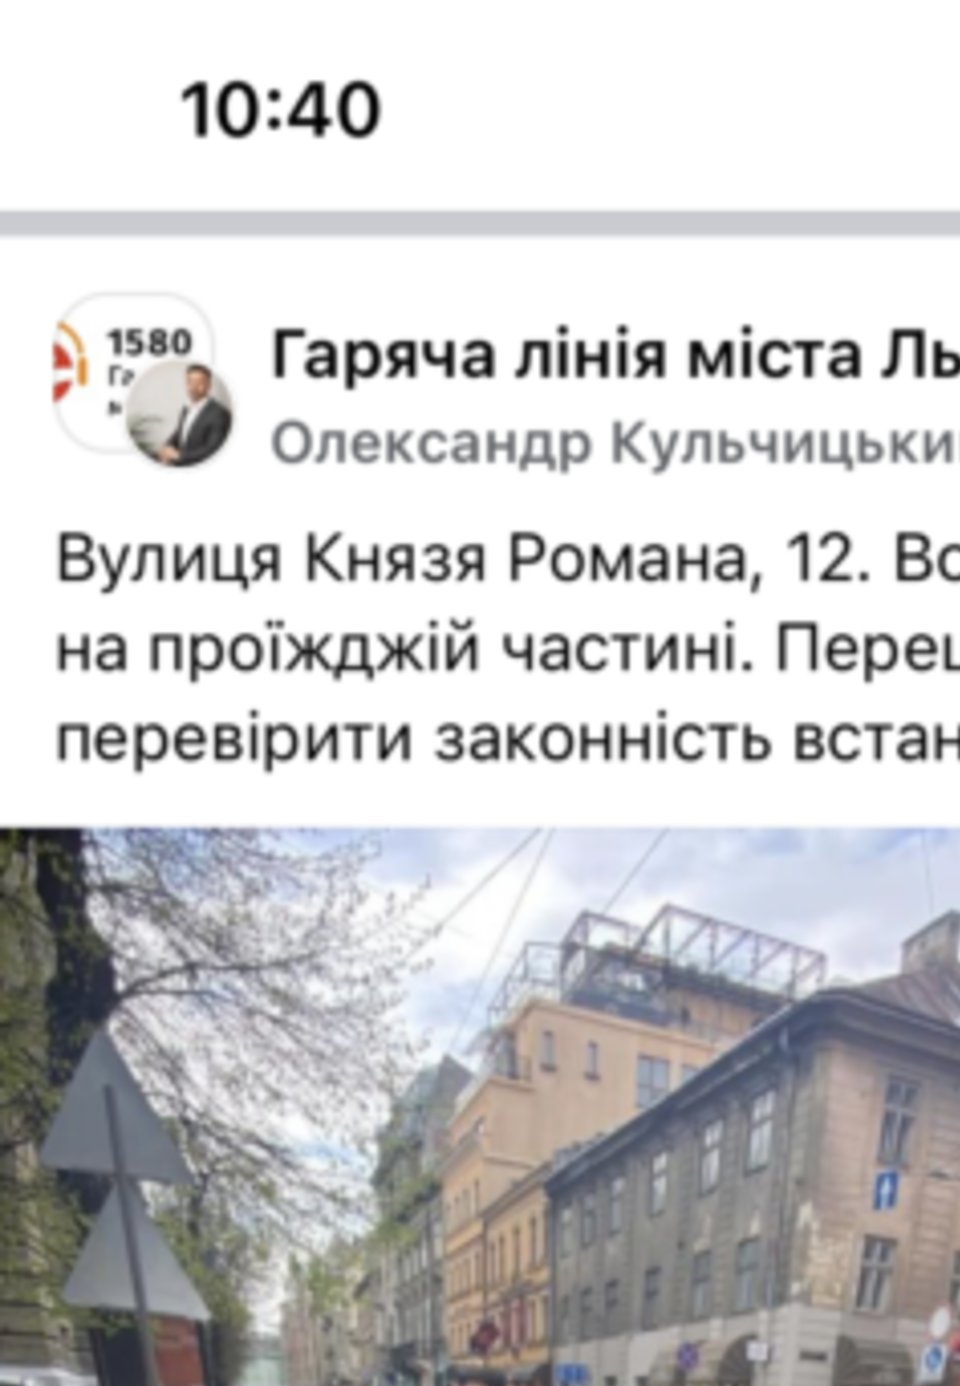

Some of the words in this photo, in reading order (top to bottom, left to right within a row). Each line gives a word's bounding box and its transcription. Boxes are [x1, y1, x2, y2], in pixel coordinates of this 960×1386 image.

[180, 79, 382, 140] 10:40
[109, 328, 192, 356] 1580
[273, 327, 496, 392] Гаряча
[514, 323, 667, 380] лінія
[688, 323, 862, 380] міста
[271, 419, 592, 474] Олександр
[58, 530, 281, 595] Вулиця
[306, 530, 486, 583] Князя
[509, 530, 762, 594] Романа,
[787, 530, 870, 583] 12.
[56, 632, 128, 673] на
[149, 617, 479, 684] проїжджій
[502, 619, 753, 673] частині.
[56, 708, 412, 774] перевірити
[434, 708, 773, 763] законність
